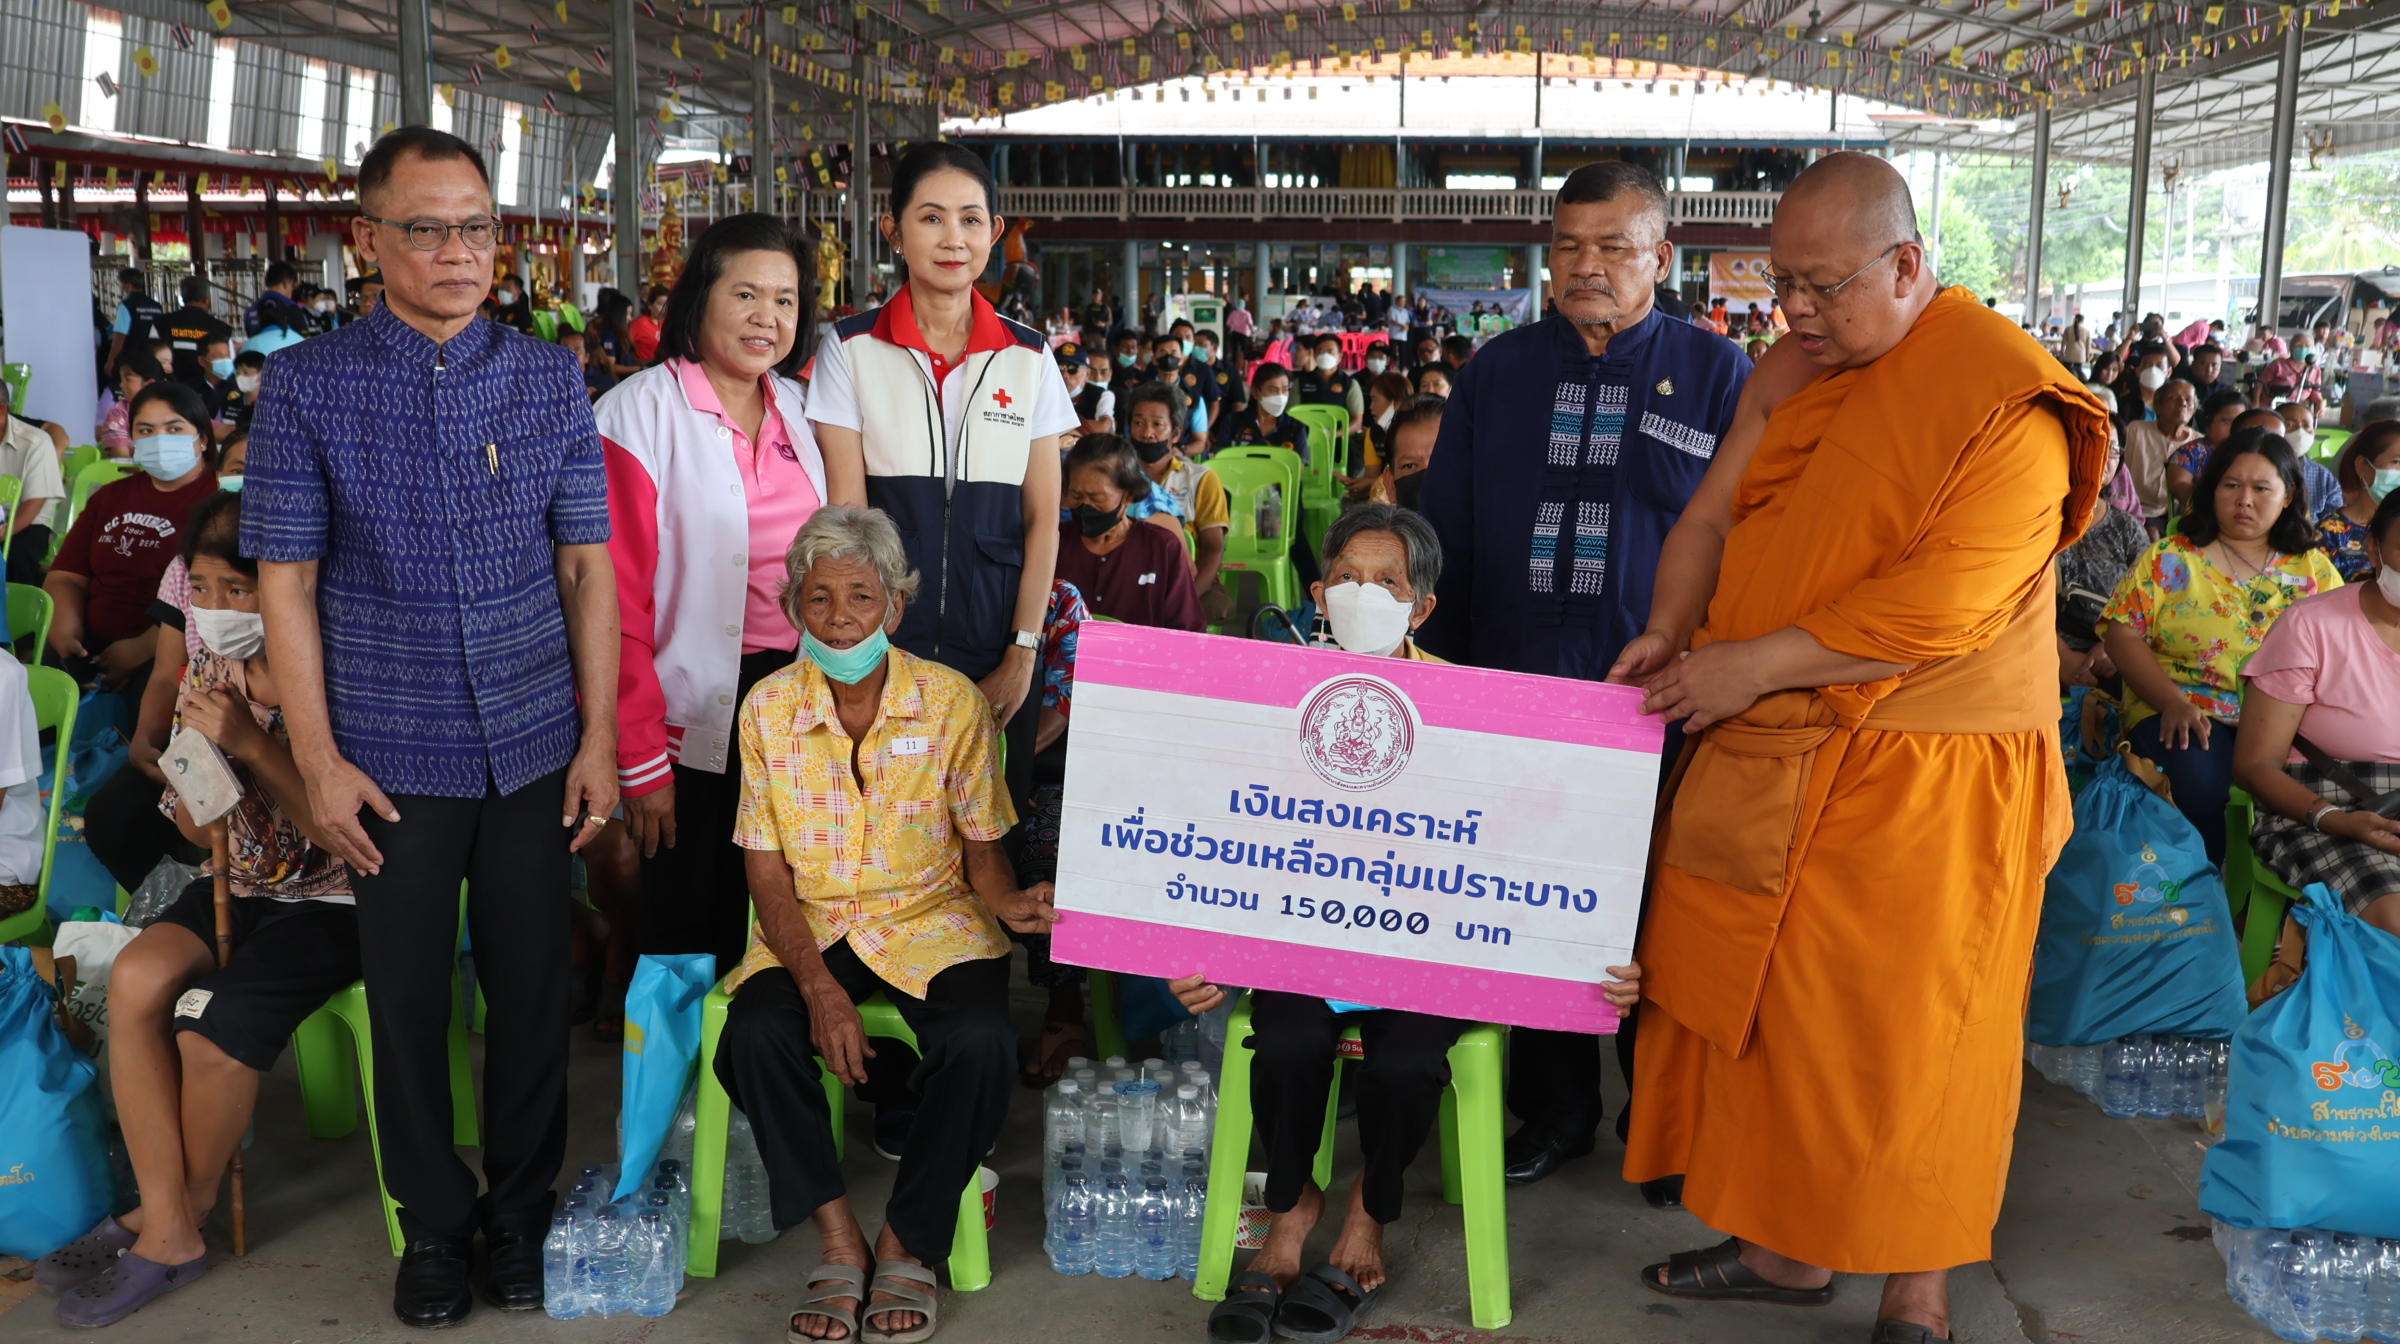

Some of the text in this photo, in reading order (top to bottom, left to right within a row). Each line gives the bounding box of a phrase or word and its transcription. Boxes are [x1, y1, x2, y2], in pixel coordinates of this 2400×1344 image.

[983, 411, 1025, 423] สภากาชาดไทย
[906, 741, 917, 750] 11
[1230, 783, 1483, 845] เงินสงเคราะห์
[1101, 807, 1598, 913] เพื่อช่วยเหลือกลุ่มเปราะบาง
[1165, 872, 1512, 946] จำนวน 150,000 บาท
[2310, 1090, 2400, 1121] สายธารน้ำใ
[2266, 1117, 2400, 1143] ด้วยความห่วงใยจ
